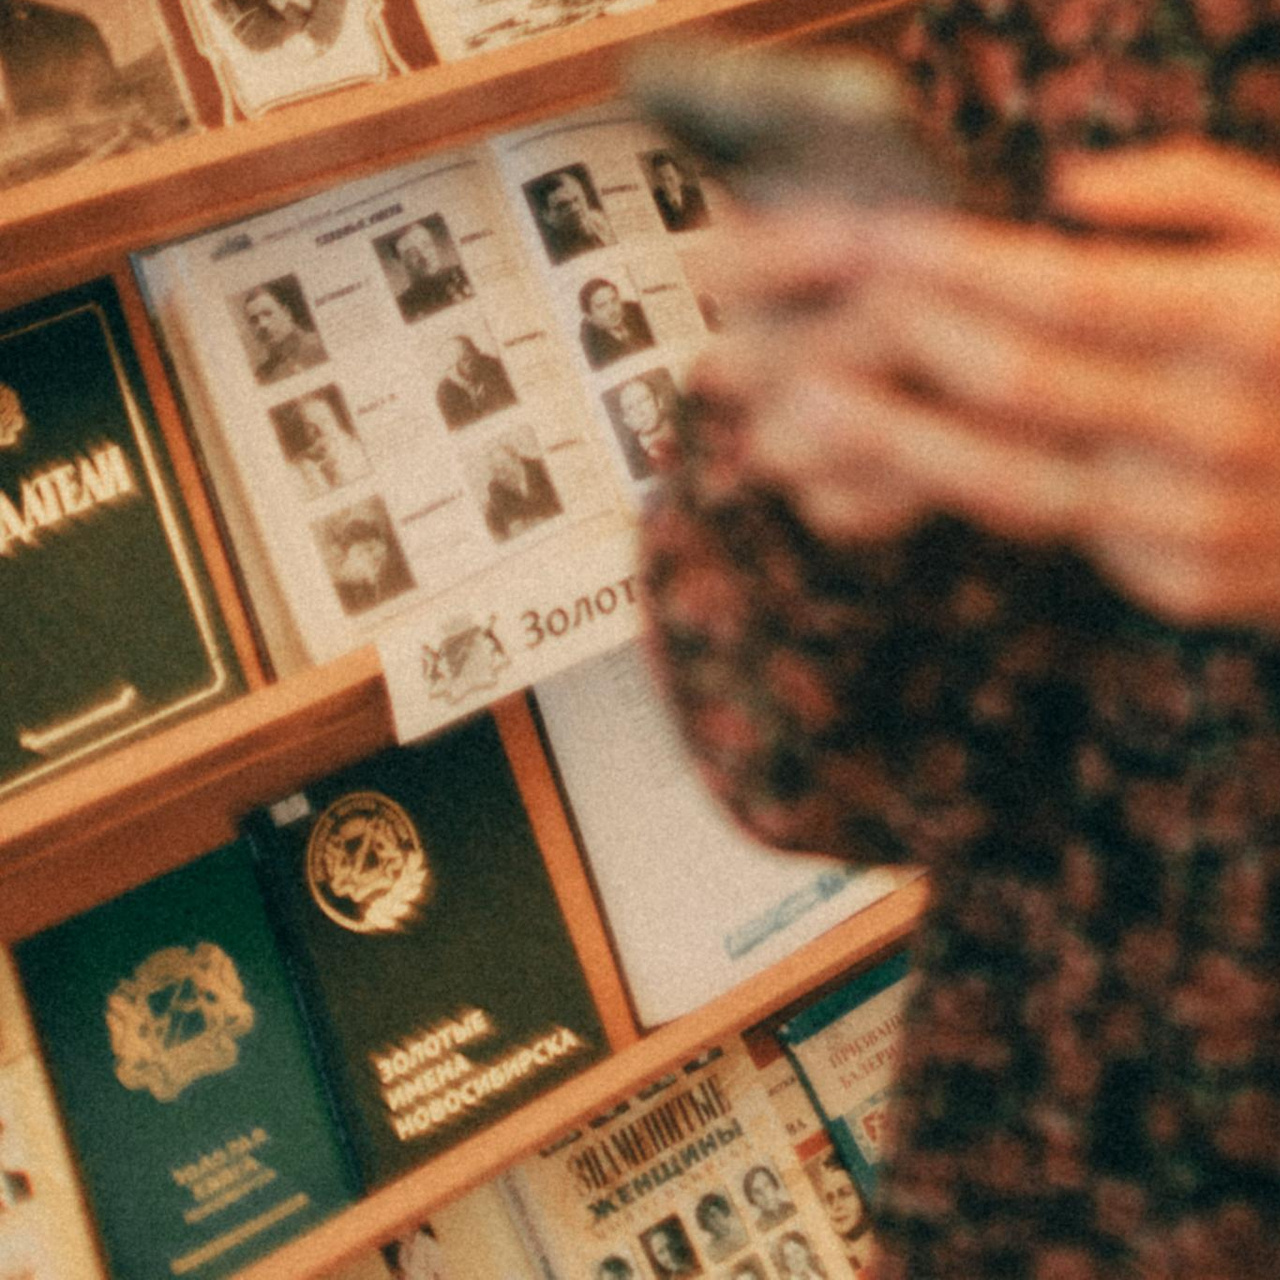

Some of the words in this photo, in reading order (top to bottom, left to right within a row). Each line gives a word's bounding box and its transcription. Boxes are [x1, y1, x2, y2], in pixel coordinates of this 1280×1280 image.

[520, 574, 637, 650] Золот
[377, 1008, 489, 1084] ЗОЛОТЫЕ
[386, 1052, 472, 1112] ИМЕНА
[394, 1026, 580, 1140] НОВОСИБИРСКА
[566, 1073, 732, 1194] ЗНАМЕНИТЫЕ
[588, 1117, 743, 1218] ЖЕНЩИНЫ
